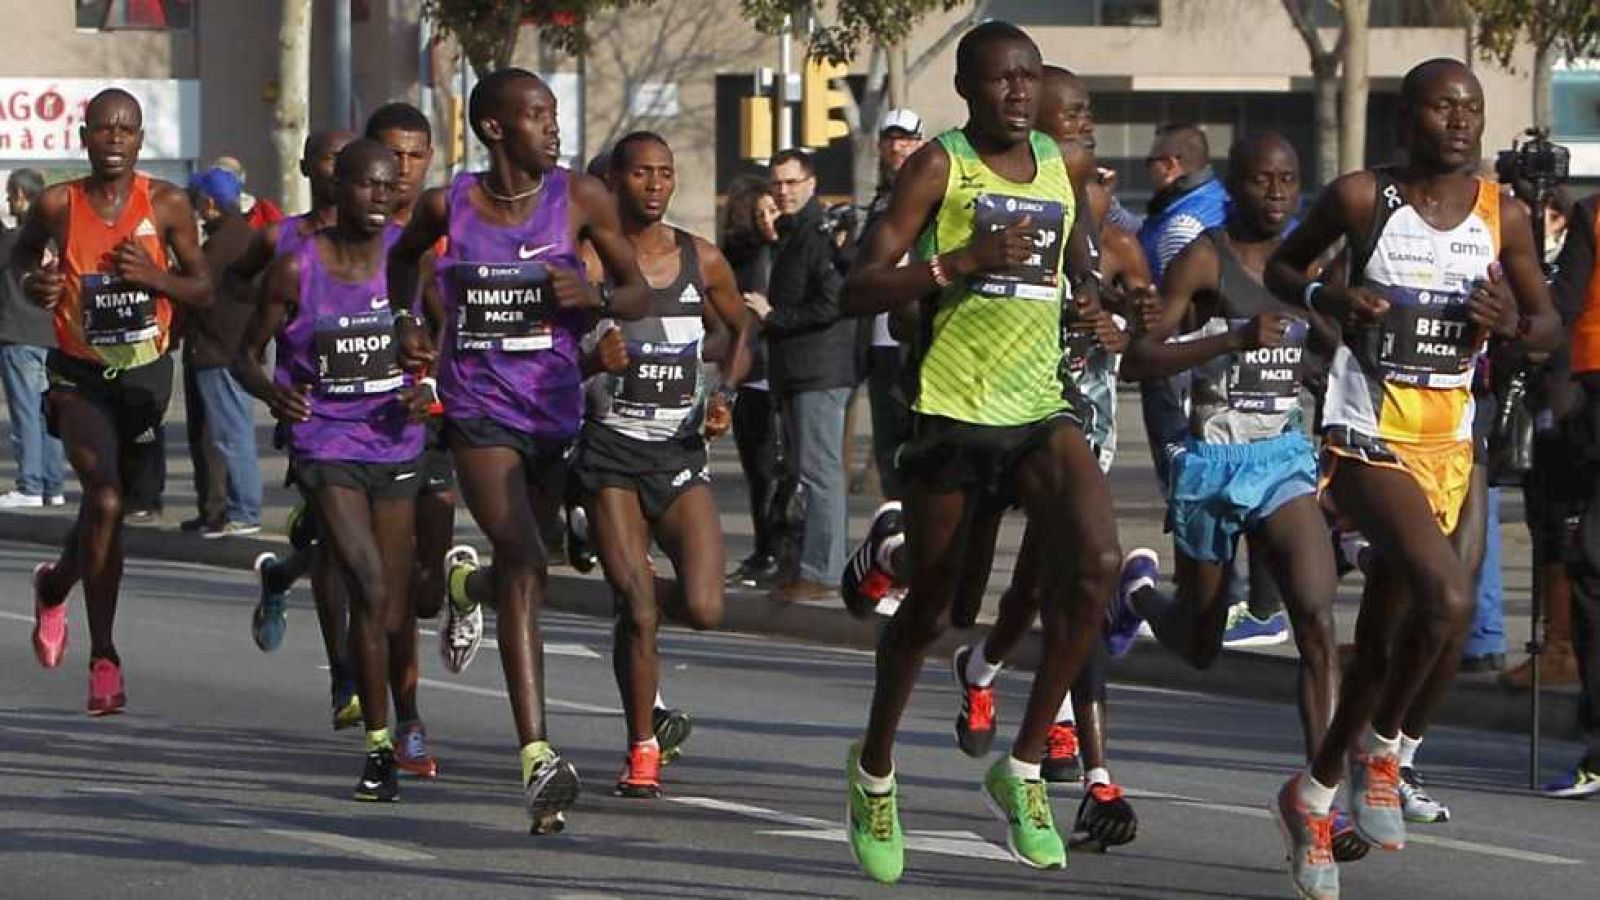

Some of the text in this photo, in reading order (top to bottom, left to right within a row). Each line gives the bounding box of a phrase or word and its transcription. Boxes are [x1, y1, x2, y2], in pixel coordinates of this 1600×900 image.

[466, 287, 542, 305] KIMUTAI
[116, 306, 133, 318] 14
[484, 311, 524, 323] PACER
[1416, 317, 1465, 339] BETT
[336, 334, 391, 353] KIROP
[1416, 342, 1457, 356] PACER
[359, 353, 369, 367] 7
[638, 364, 684, 380] SEFIR
[1261, 369, 1294, 380] PACER
[655, 381, 664, 393] 1
